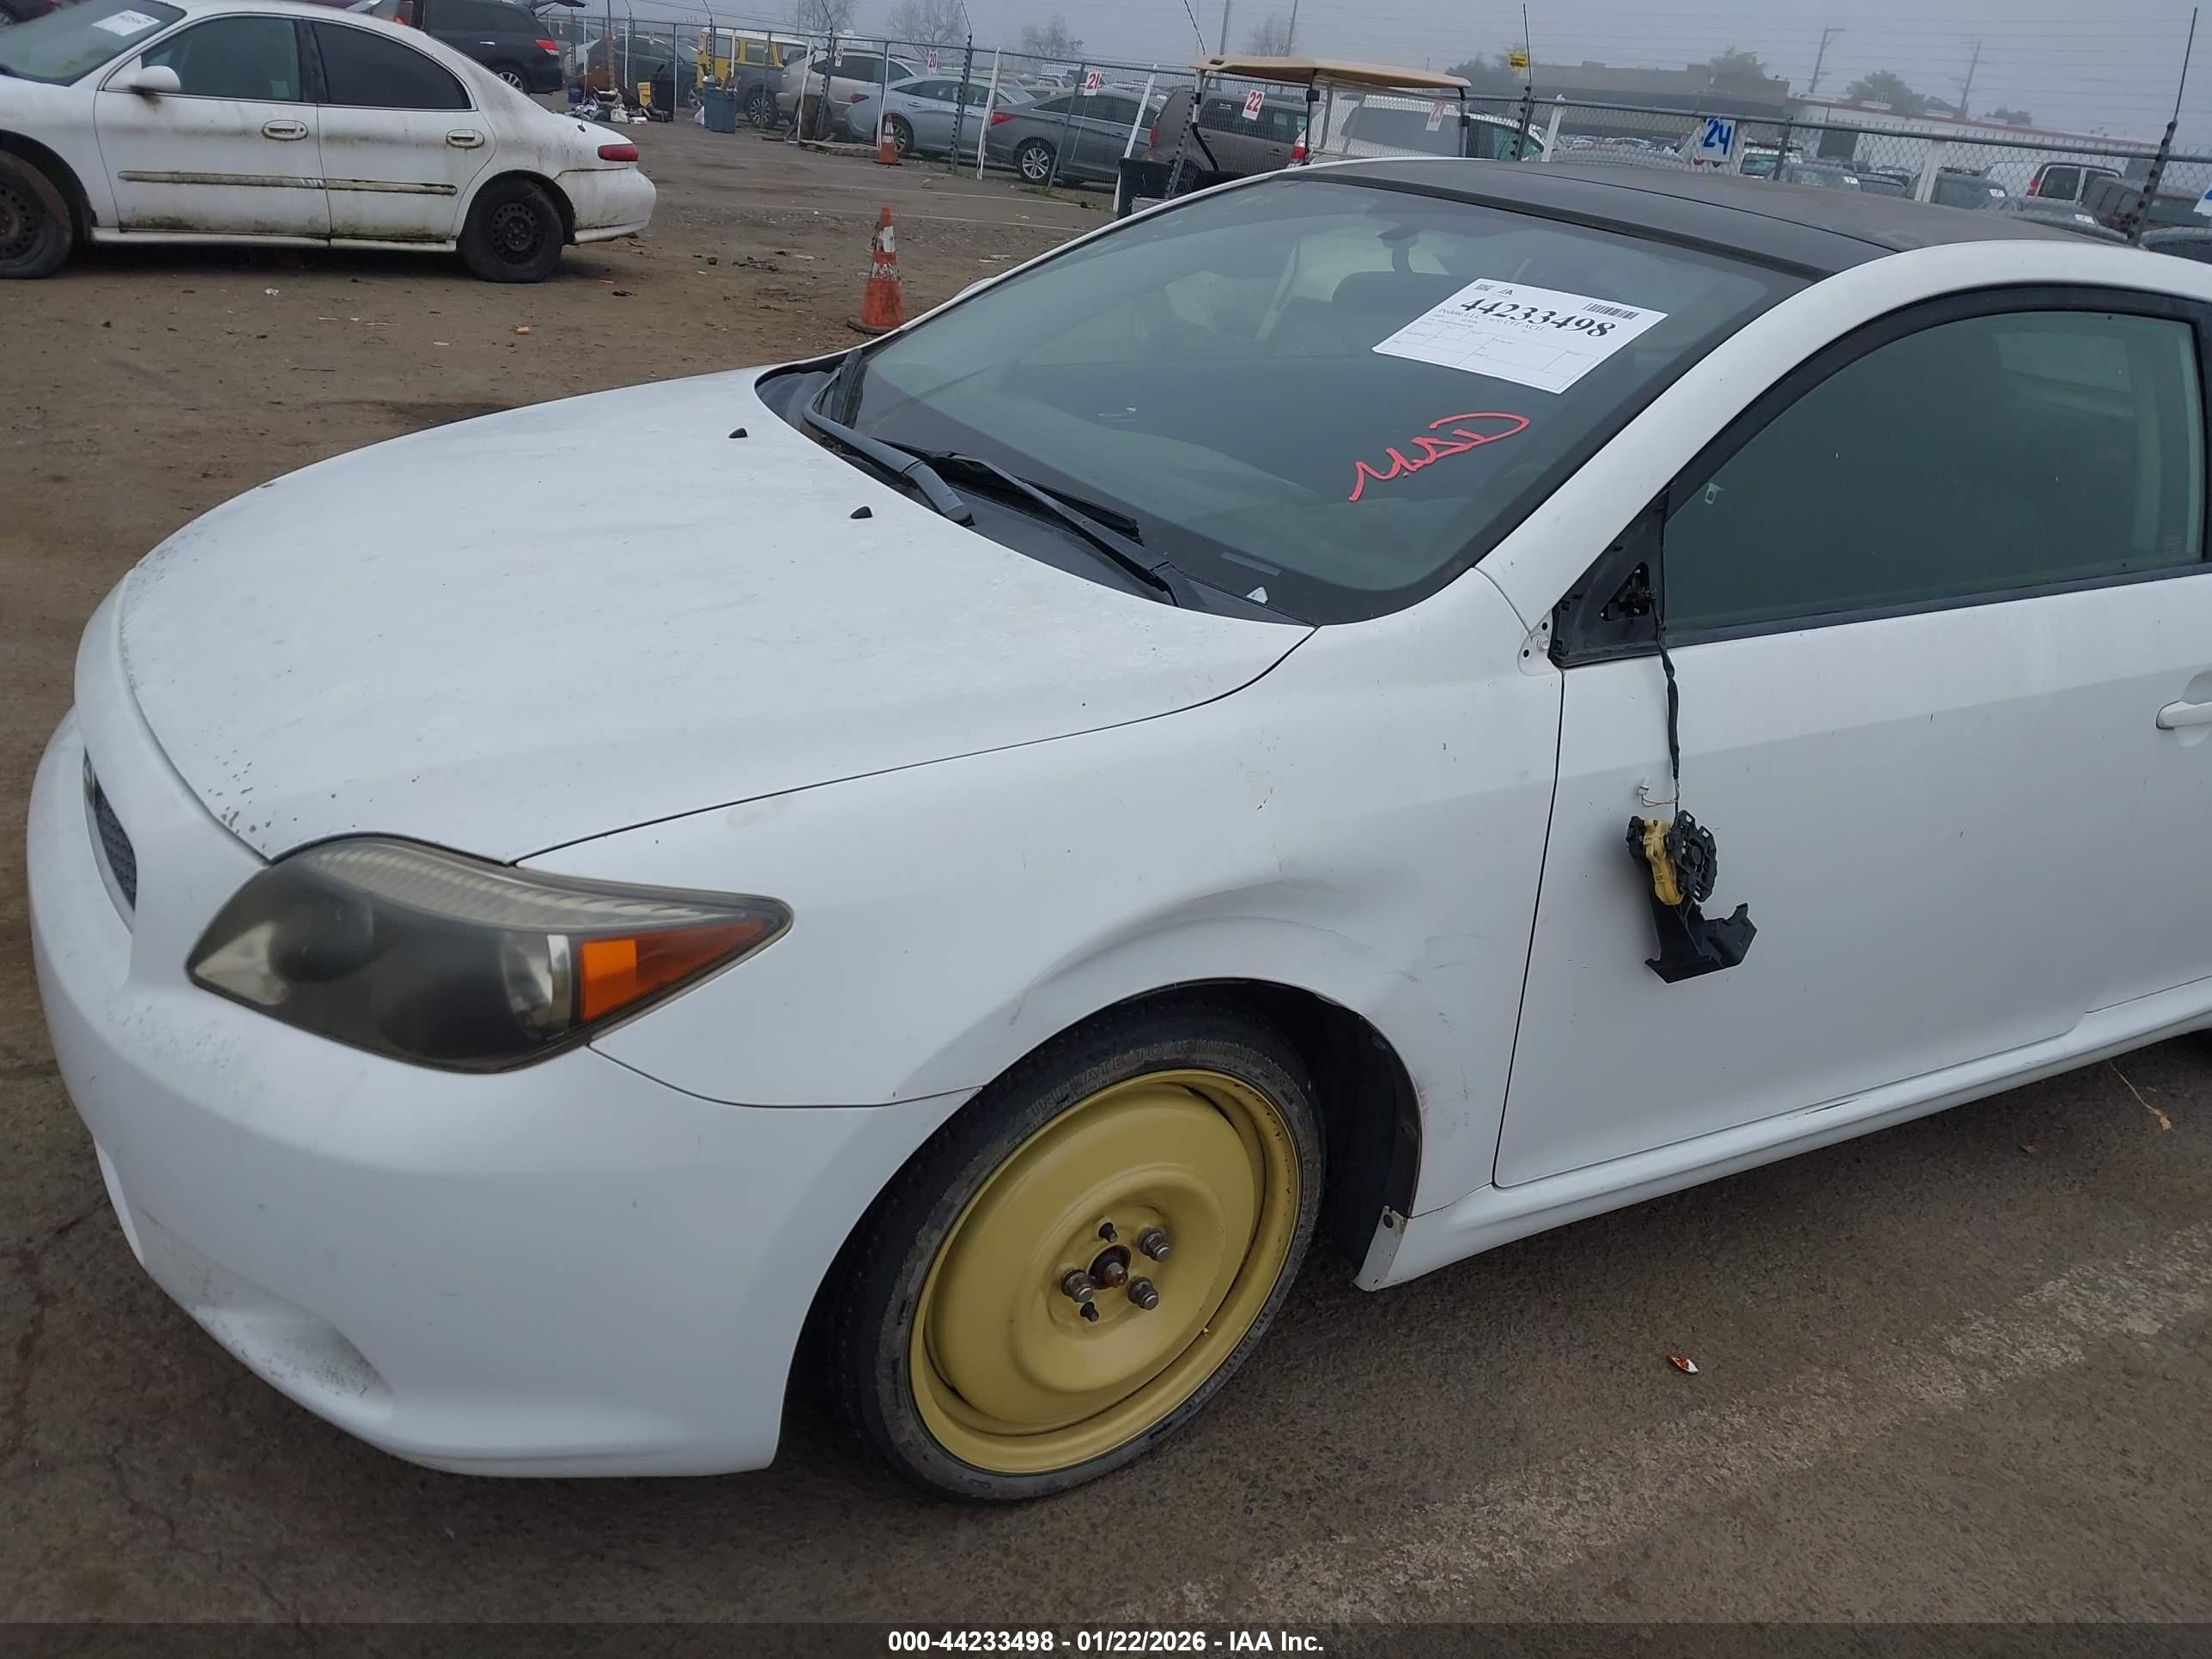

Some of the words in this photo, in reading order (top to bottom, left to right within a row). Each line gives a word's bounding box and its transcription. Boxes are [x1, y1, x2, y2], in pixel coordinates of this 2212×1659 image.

[928, 52, 937, 68] 20
[1085, 72, 1101, 90] 21
[1245, 90, 1263, 112] 22
[1429, 102, 1443, 123] 23
[1703, 118, 1732, 155] 24
[1460, 298, 1616, 337] 44233498
